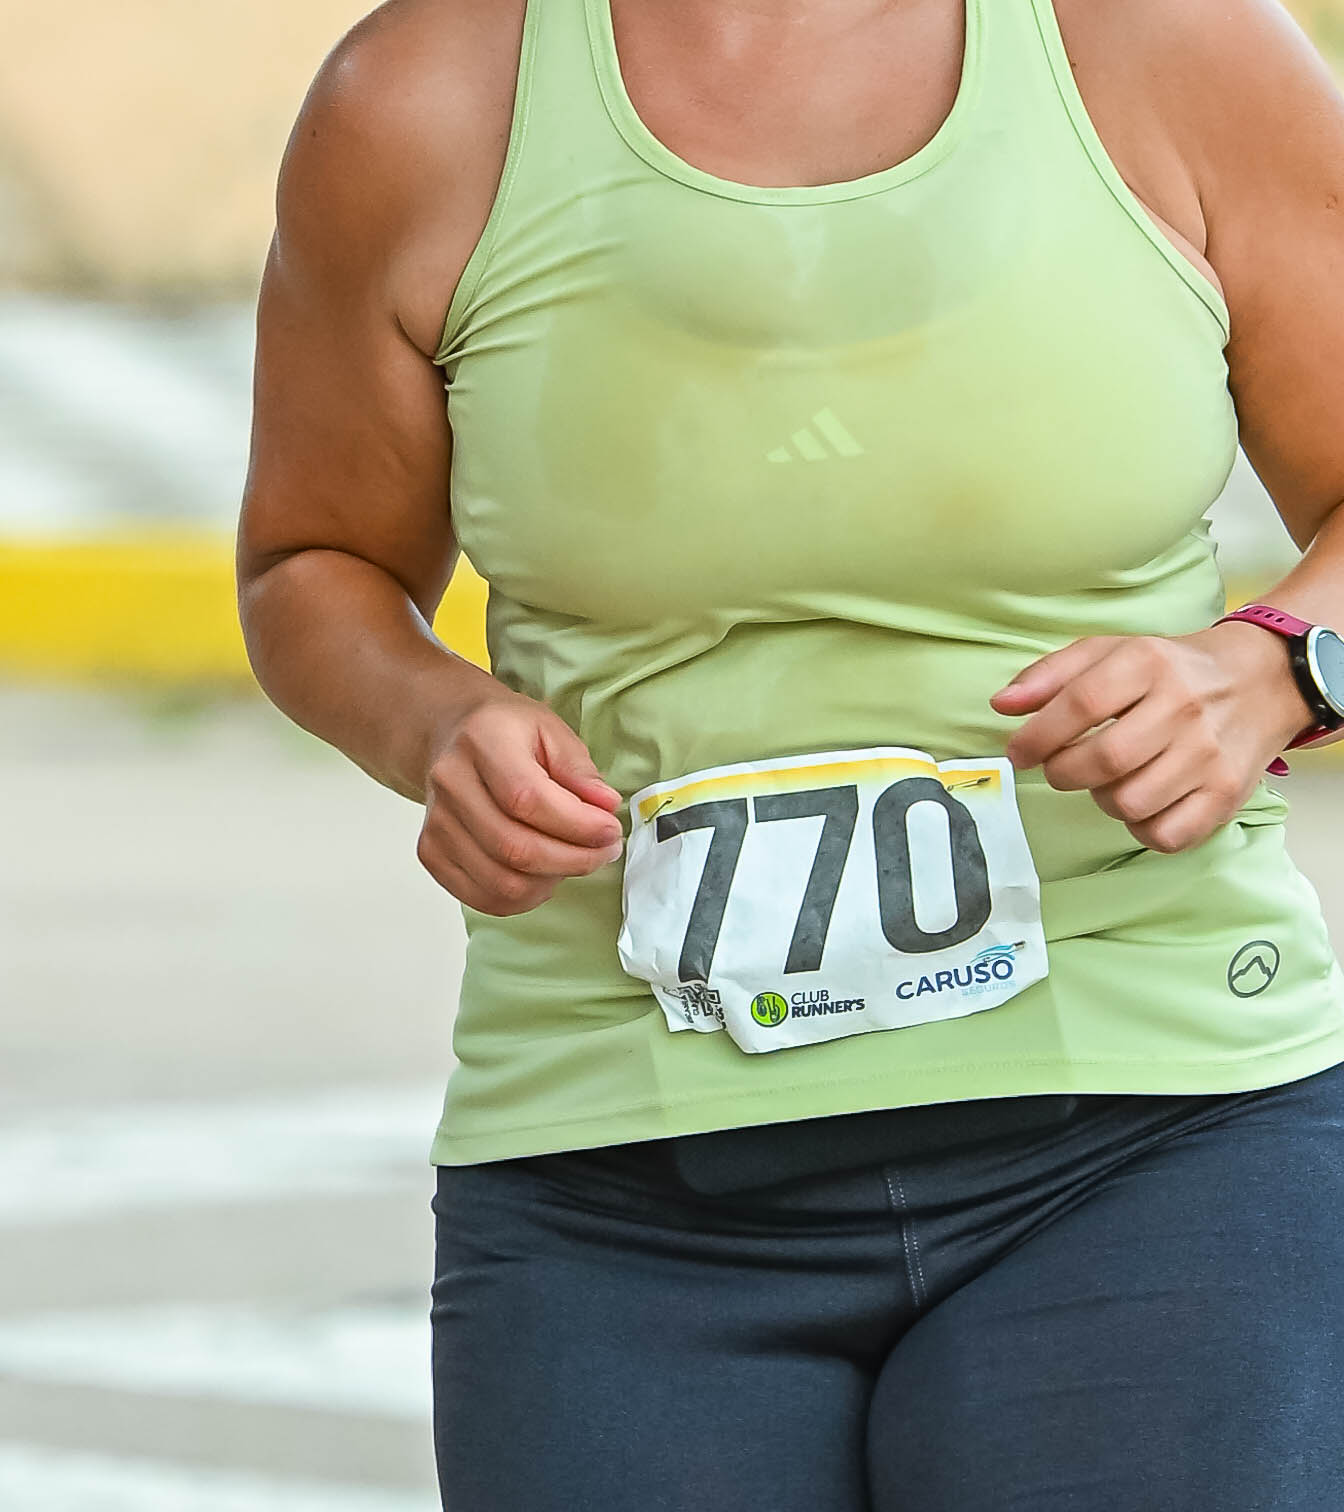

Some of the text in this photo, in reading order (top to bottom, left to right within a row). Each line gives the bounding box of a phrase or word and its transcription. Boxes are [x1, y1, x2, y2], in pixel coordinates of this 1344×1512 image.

[655, 777, 992, 984] 770
[895, 959, 1014, 1000] CARUSO
[790, 989, 830, 1005] CLUB
[791, 998, 866, 1019] RUNNER'S
